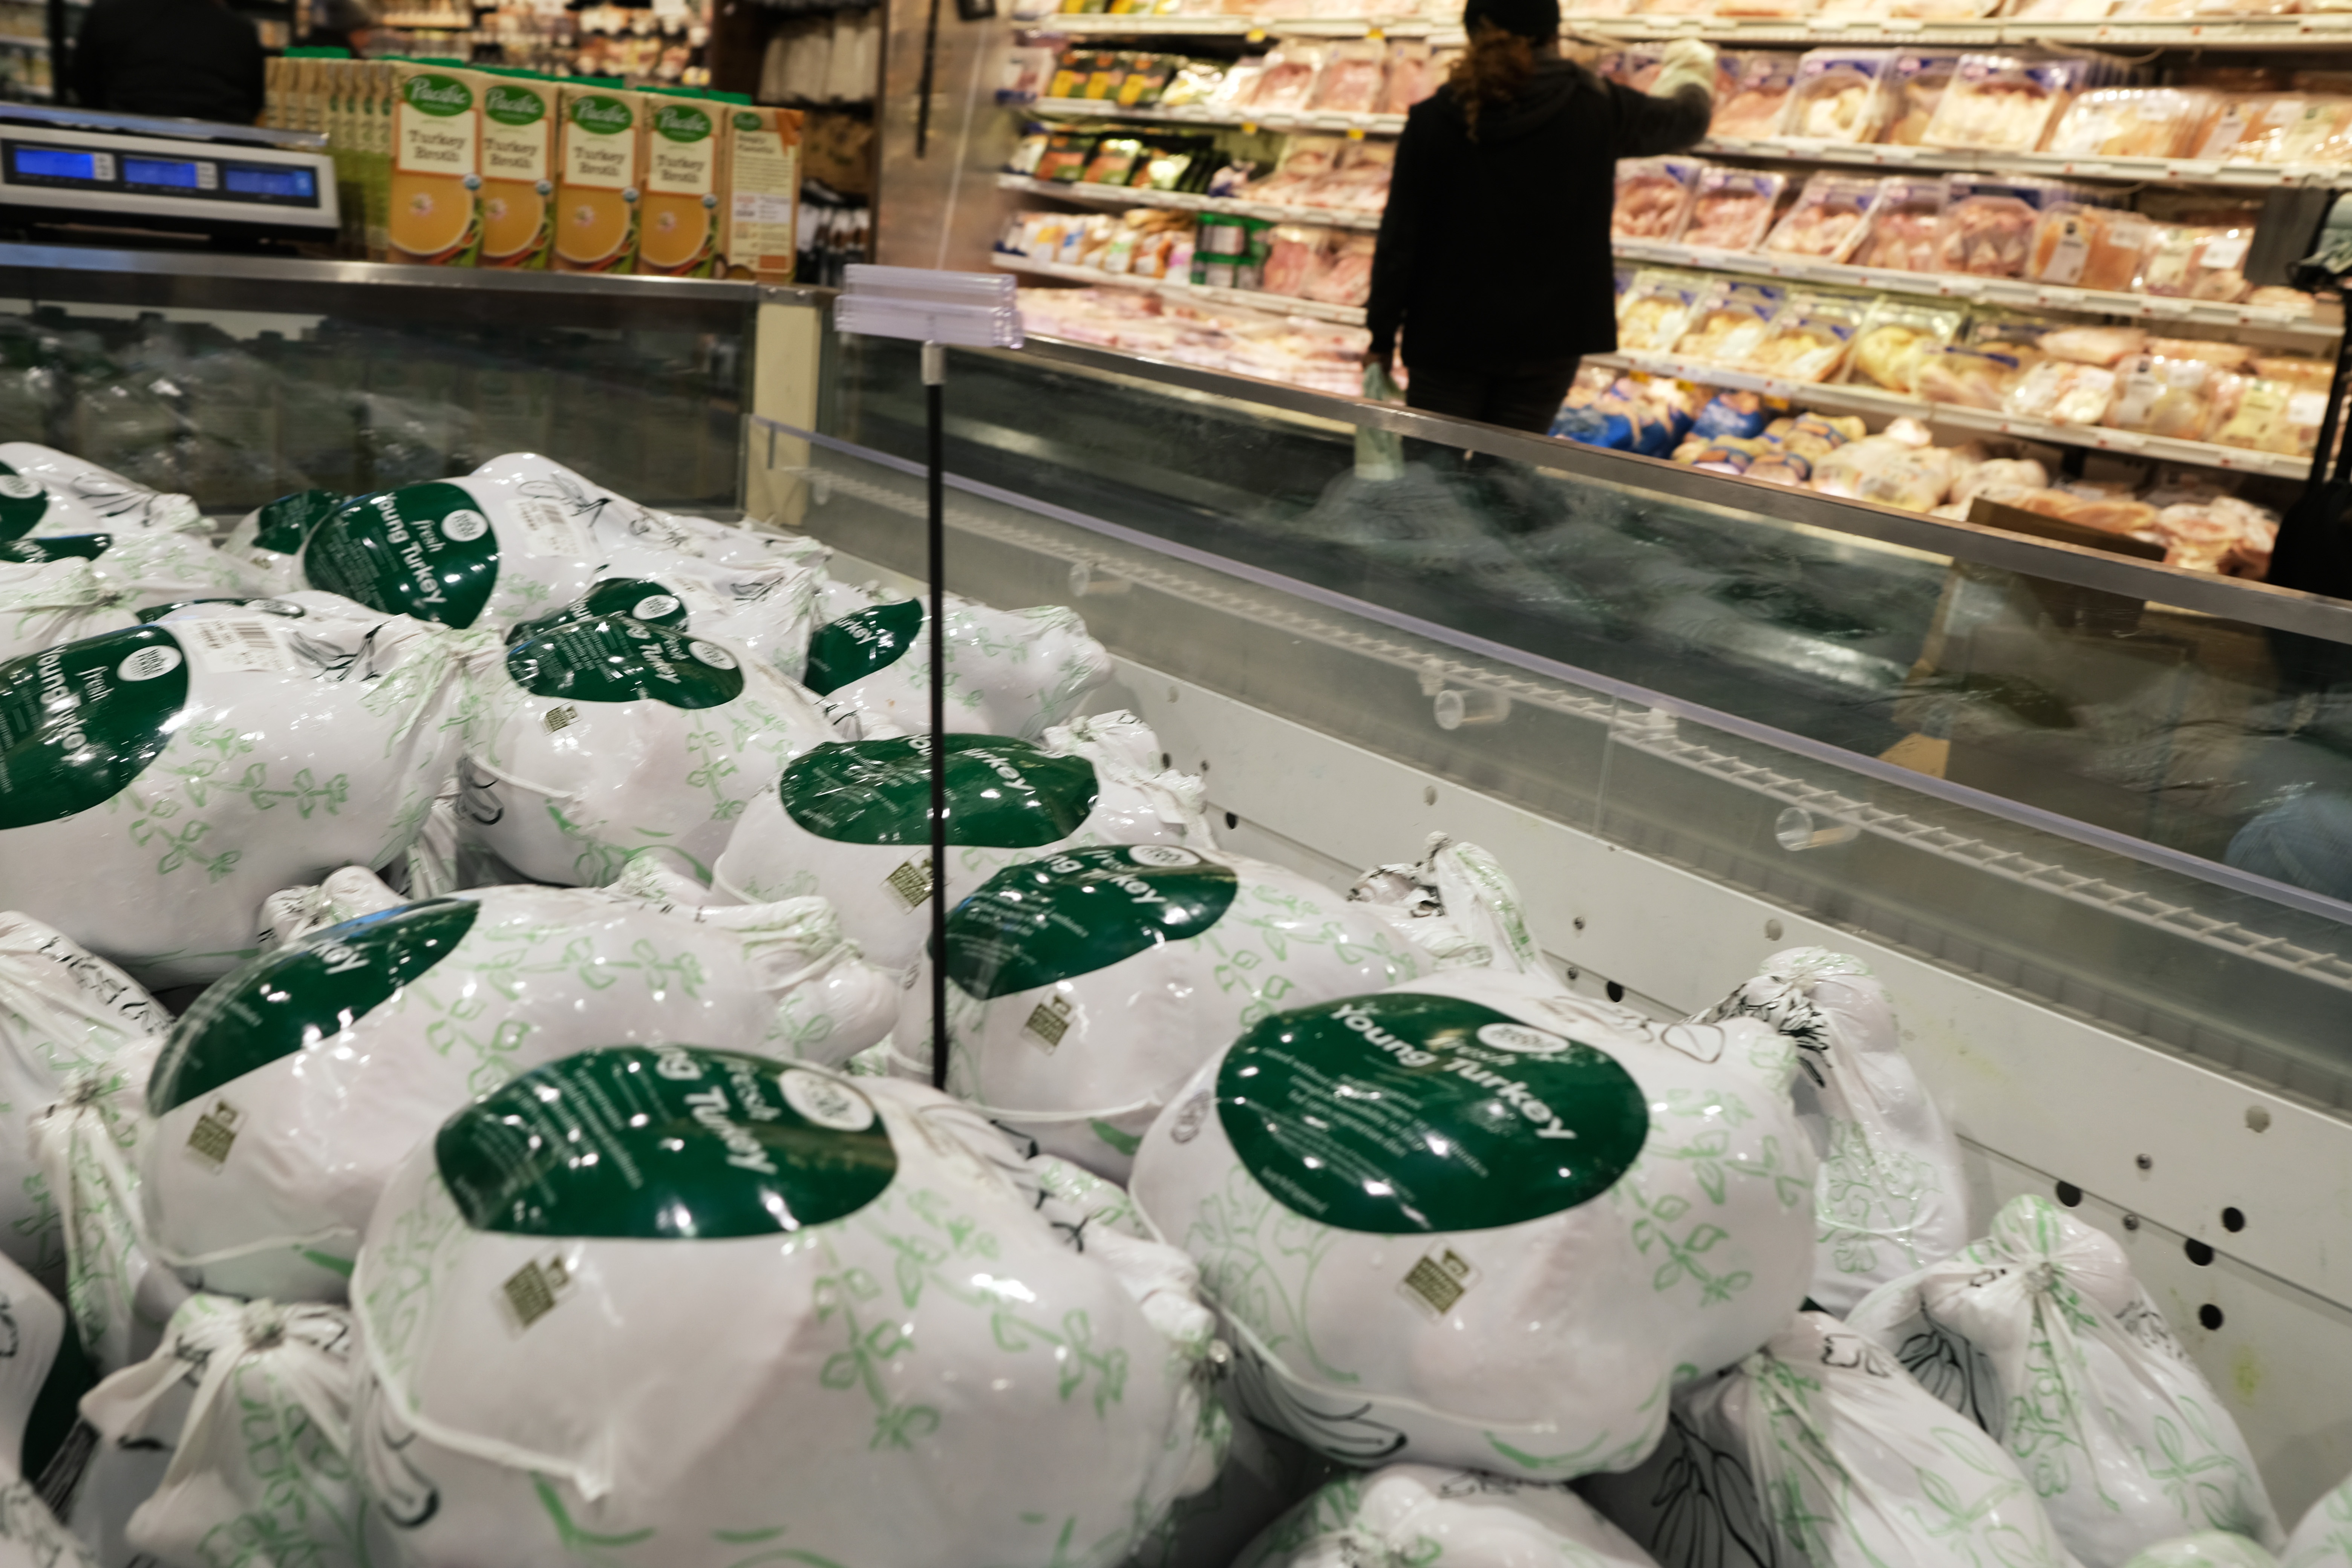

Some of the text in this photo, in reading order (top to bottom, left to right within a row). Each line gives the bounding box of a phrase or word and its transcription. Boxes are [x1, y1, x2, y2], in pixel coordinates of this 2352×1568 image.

[409, 129, 466, 150] Turkey
[484, 138, 538, 156] Turkey
[415, 147, 460, 162] Broth
[490, 154, 533, 168] Broth
[574, 146, 625, 165] Turkey
[657, 154, 705, 172] Turkey
[579, 162, 619, 176] Broth
[661, 169, 699, 183] Broth
[410, 519, 446, 553] fresh
[378, 492, 447, 603] Young Turkey
[567, 595, 594, 622] Youn
[37, 645, 69, 704] Young
[75, 666, 115, 703] fresh
[1331, 1003, 1438, 1067] Young
[1442, 1057, 1577, 1139] Turkey
